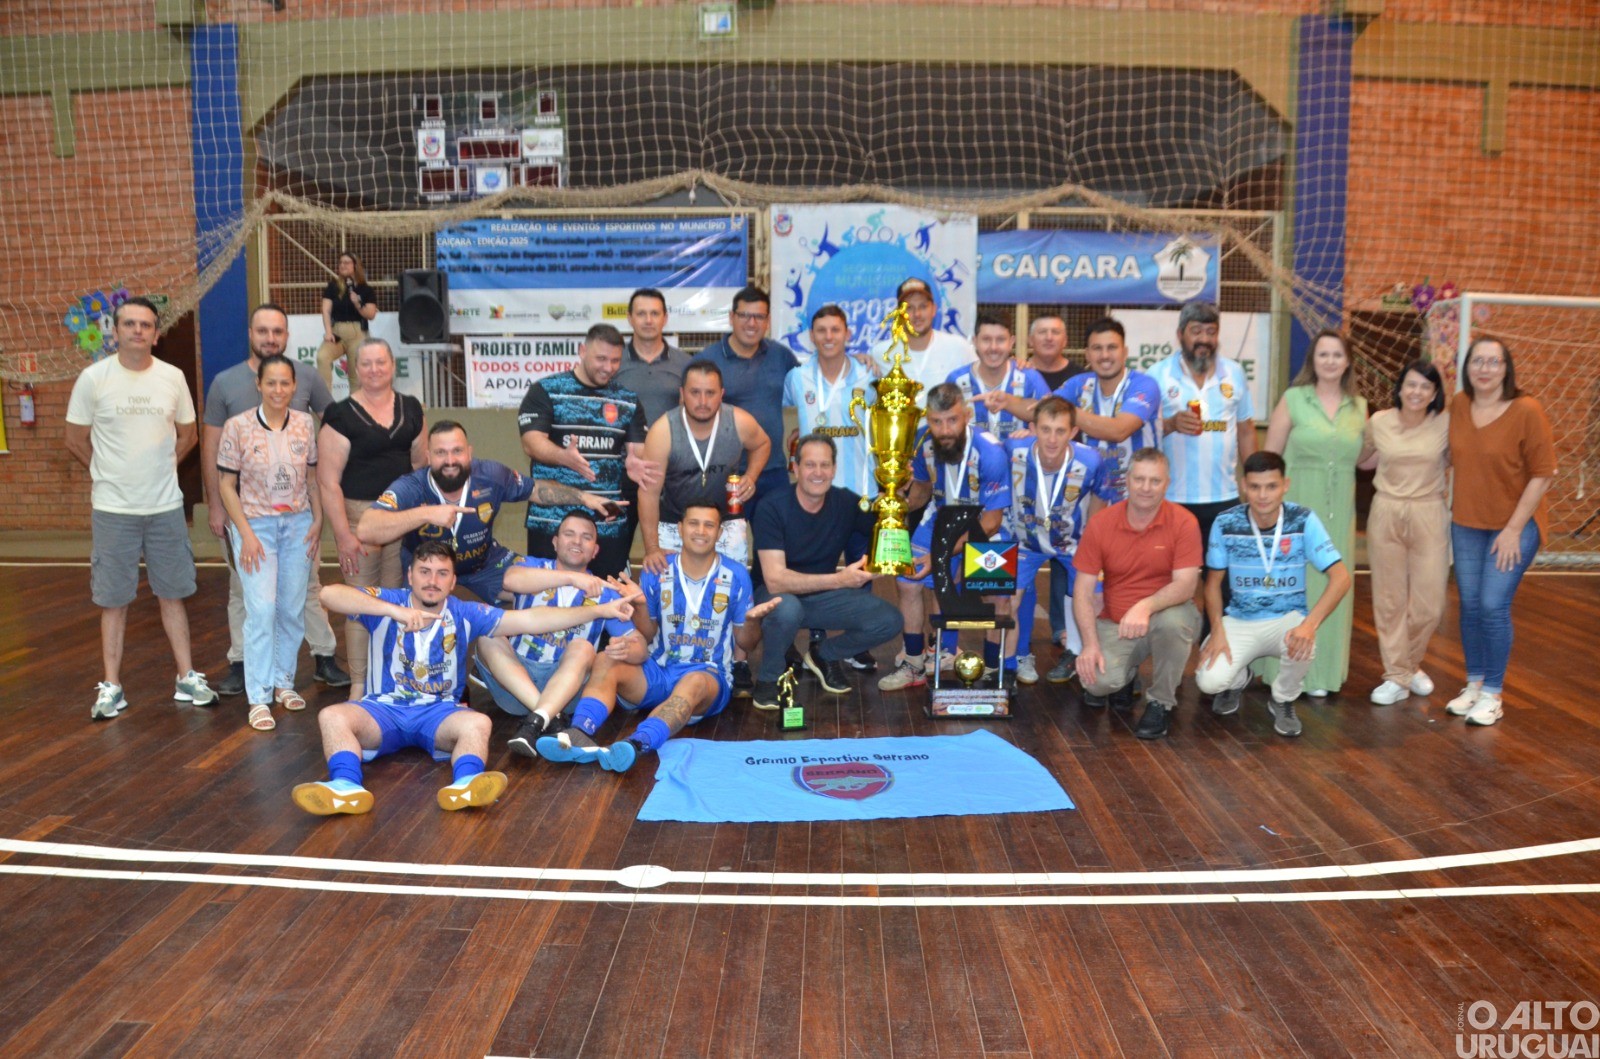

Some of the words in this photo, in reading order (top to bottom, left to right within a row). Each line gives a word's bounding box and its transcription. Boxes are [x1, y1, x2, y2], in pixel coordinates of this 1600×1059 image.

[490, 222, 542, 233] REALIZAÇÃO
[546, 223, 558, 232] DE
[562, 222, 600, 232] EVENTOS
[605, 222, 656, 231] ESPORTIVOS
[660, 222, 674, 231] NO
[679, 219, 726, 230] MUNICÍPIO
[436, 237, 472, 248] CAIÇARA
[477, 236, 508, 248] EDIÇÃO
[509, 237, 529, 246] 2025
[992, 253, 1142, 285] CAIÇARA
[297, 345, 317, 359] pr
[471, 341, 531, 356] PROJETO
[1140, 340, 1172, 357] pró
[472, 361, 520, 373] TODOS
[128, 396, 151, 404] new
[116, 404, 164, 416] balance
[661, 589, 672, 610] 9
[801, 753, 870, 766] Esportivo
[873, 752, 930, 762] Serrano
